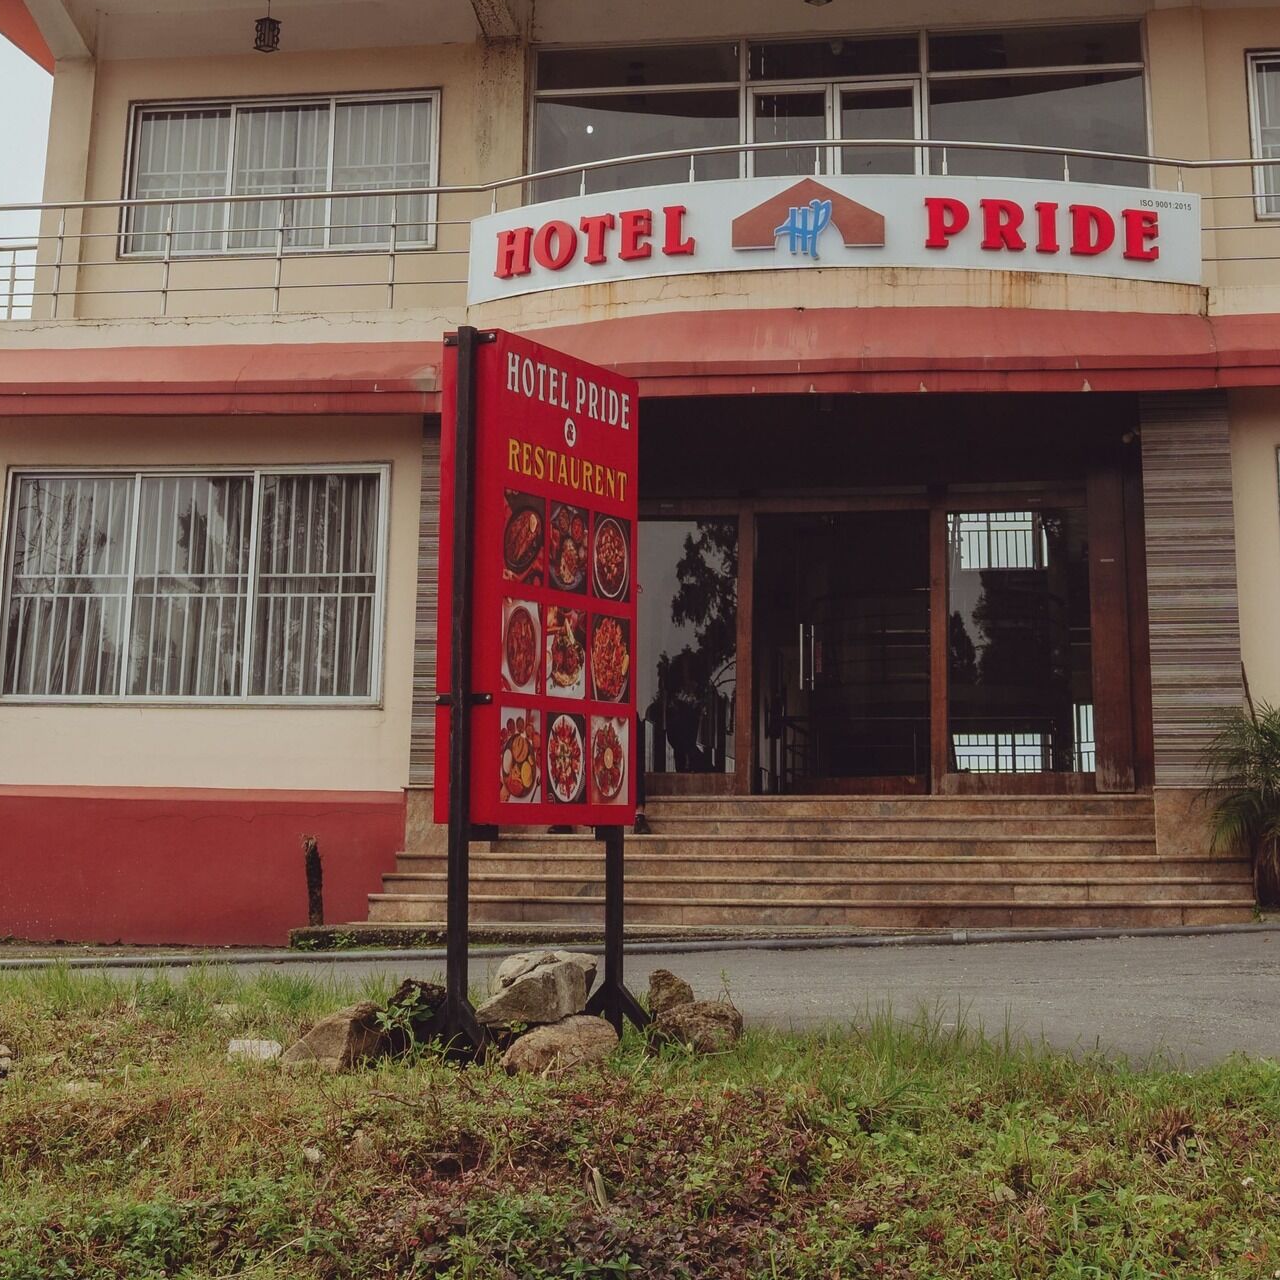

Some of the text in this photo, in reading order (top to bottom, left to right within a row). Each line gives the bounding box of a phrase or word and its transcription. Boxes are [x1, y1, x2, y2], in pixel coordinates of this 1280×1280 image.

[1139, 199, 1192, 211] ISO 9001:2015
[494, 197, 1160, 280] HOTEL PRIDE
[507, 351, 630, 430] HOTEL PRIDE
[565, 421, 576, 444] &
[508, 438, 628, 502] RESTAURENT
